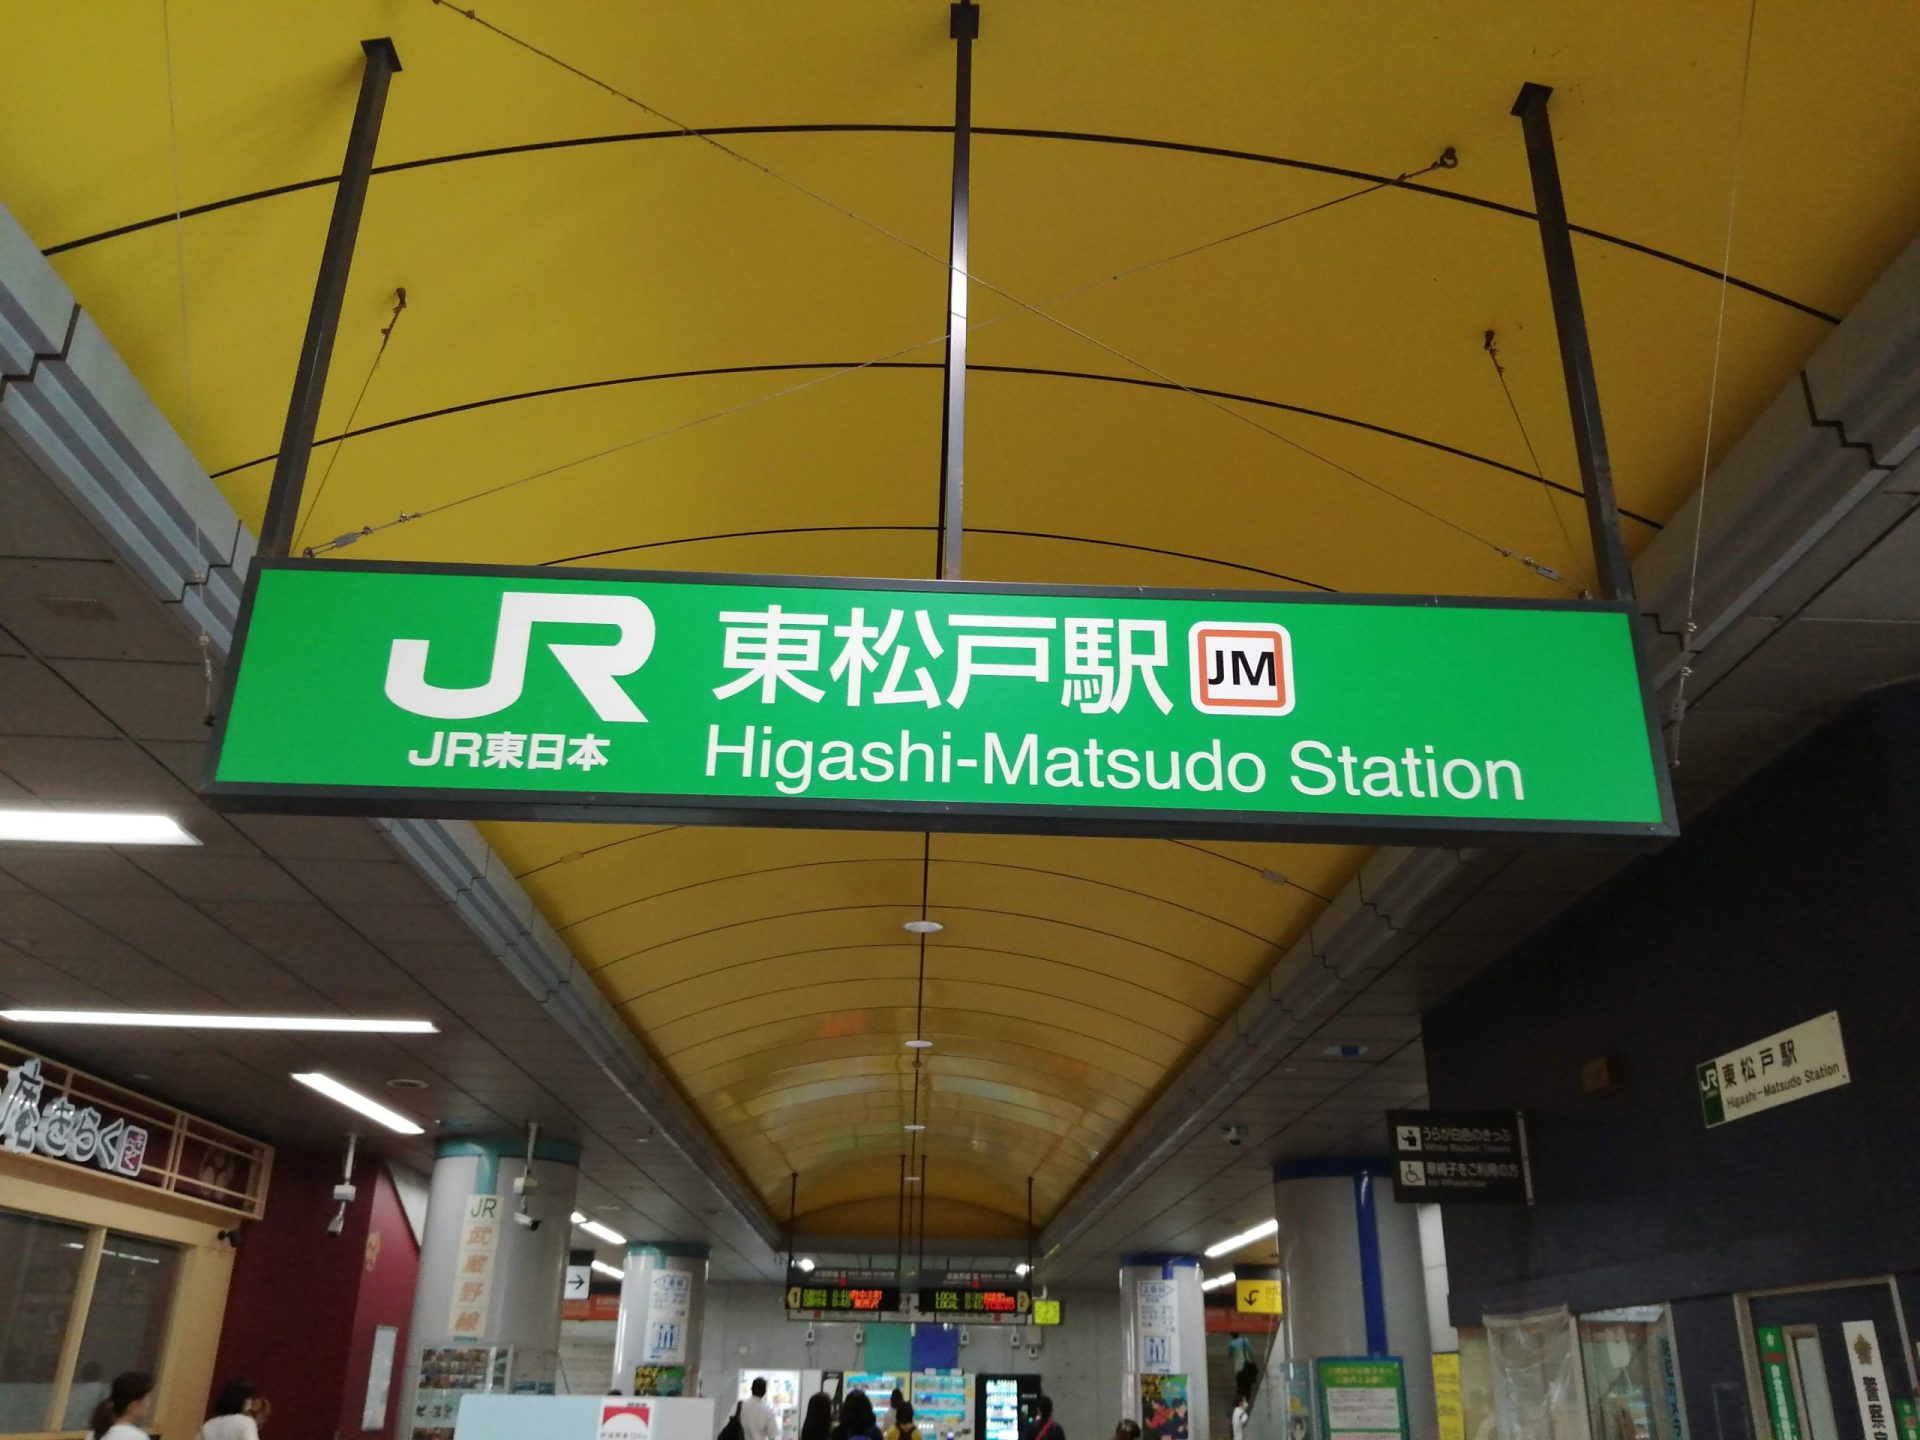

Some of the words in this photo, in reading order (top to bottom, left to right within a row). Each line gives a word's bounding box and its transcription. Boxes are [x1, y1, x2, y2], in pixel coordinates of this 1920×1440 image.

[384, 591, 657, 723] JR
[712, 604, 1175, 716] 東松戸駅
[1207, 650, 1277, 687] JM
[408, 730, 611, 773] JR東日本
[705, 724, 1267, 795] Higashi-Matsudo
[1290, 739, 1525, 801] Station
[1701, 1068, 1718, 1092] JR
[1721, 1039, 1798, 1089] 東松戸駅
[1726, 1075, 1802, 1110] Higashi-Matsudo
[1803, 1062, 1841, 1084] Station
[470, 1197, 498, 1218] JR
